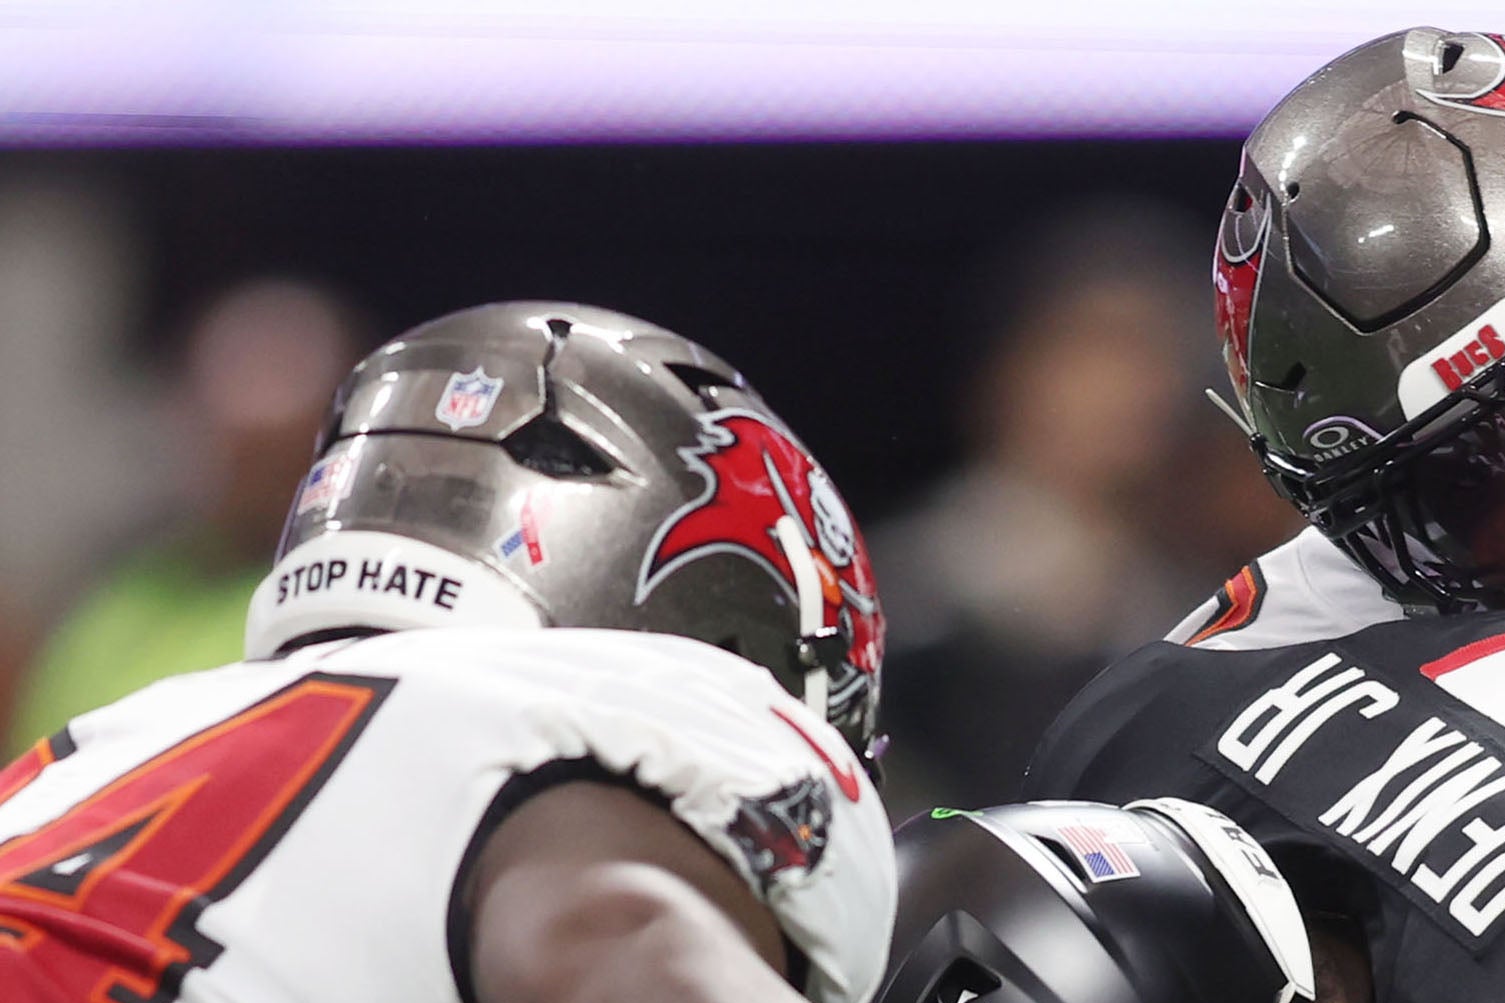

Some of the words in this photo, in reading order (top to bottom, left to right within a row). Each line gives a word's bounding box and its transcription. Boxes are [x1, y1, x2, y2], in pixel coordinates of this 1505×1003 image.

[443, 393, 483, 419] NFL
[1313, 436, 1369, 462] OAKLEY
[277, 560, 347, 604] STOP
[358, 560, 462, 609] HATE
[1217, 652, 1399, 786] JR
